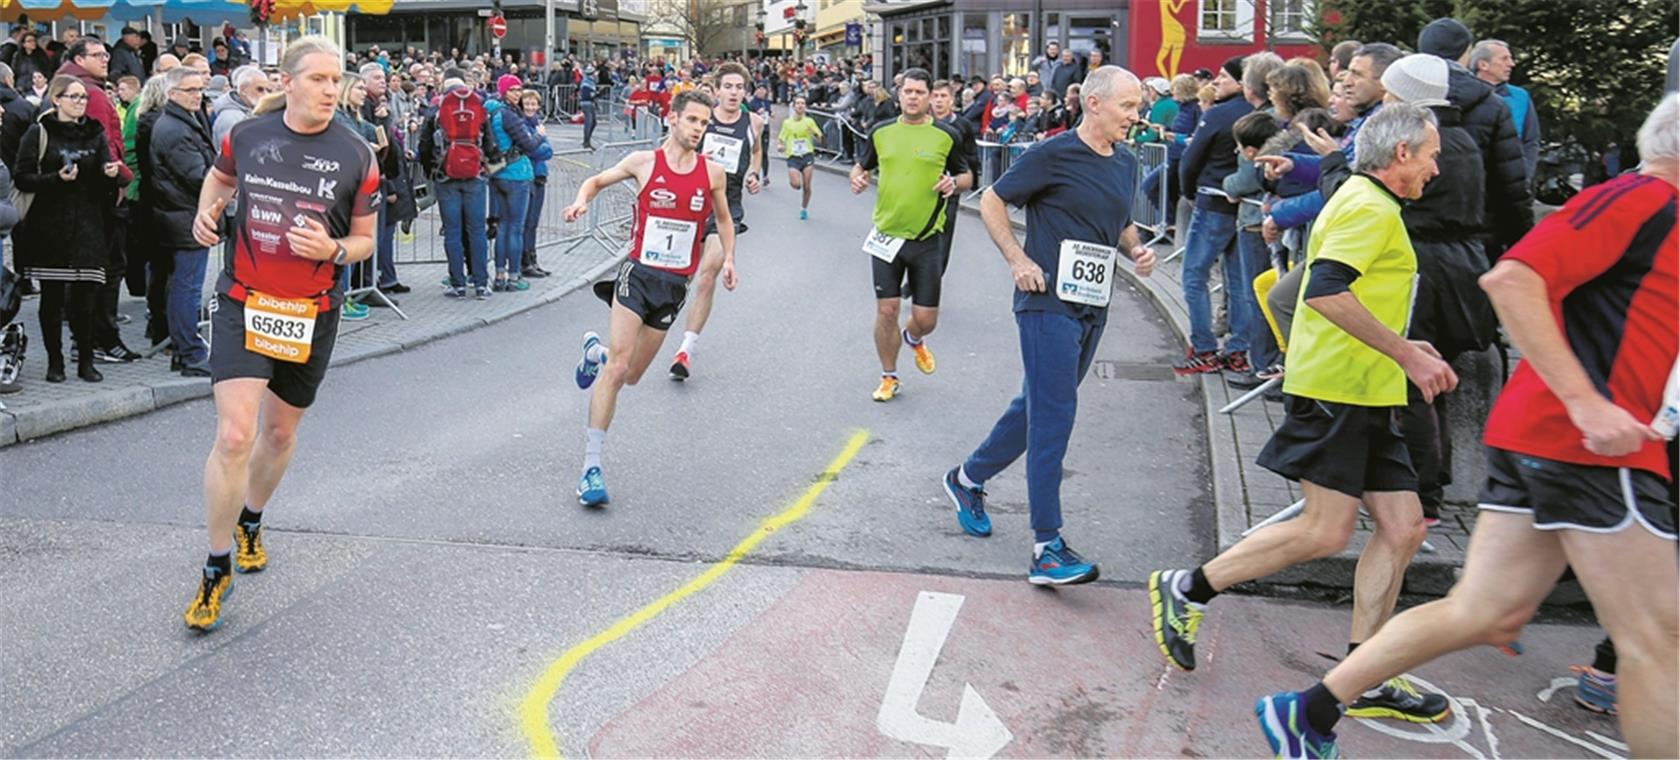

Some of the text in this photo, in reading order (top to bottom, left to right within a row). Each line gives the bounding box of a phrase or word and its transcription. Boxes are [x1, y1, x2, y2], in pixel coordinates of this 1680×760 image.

[665, 234, 673, 251] 1
[1072, 259, 1105, 284] 638
[251, 314, 306, 339] 65833
